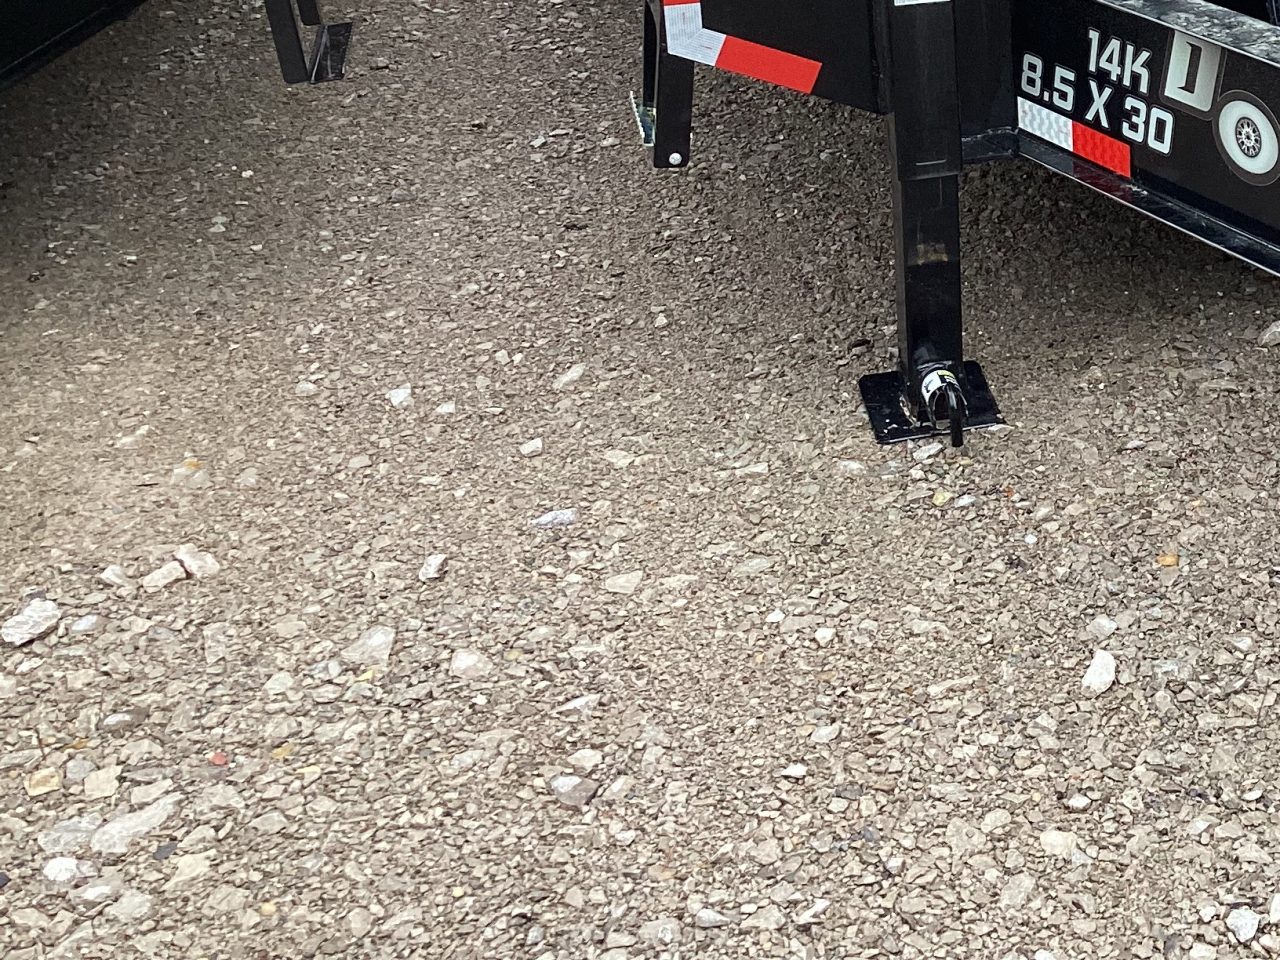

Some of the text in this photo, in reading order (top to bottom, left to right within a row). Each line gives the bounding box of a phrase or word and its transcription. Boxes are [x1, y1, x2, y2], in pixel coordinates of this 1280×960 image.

[1088, 29, 1151, 94] 14K
[1021, 53, 1174, 155] 8.5 X 30
